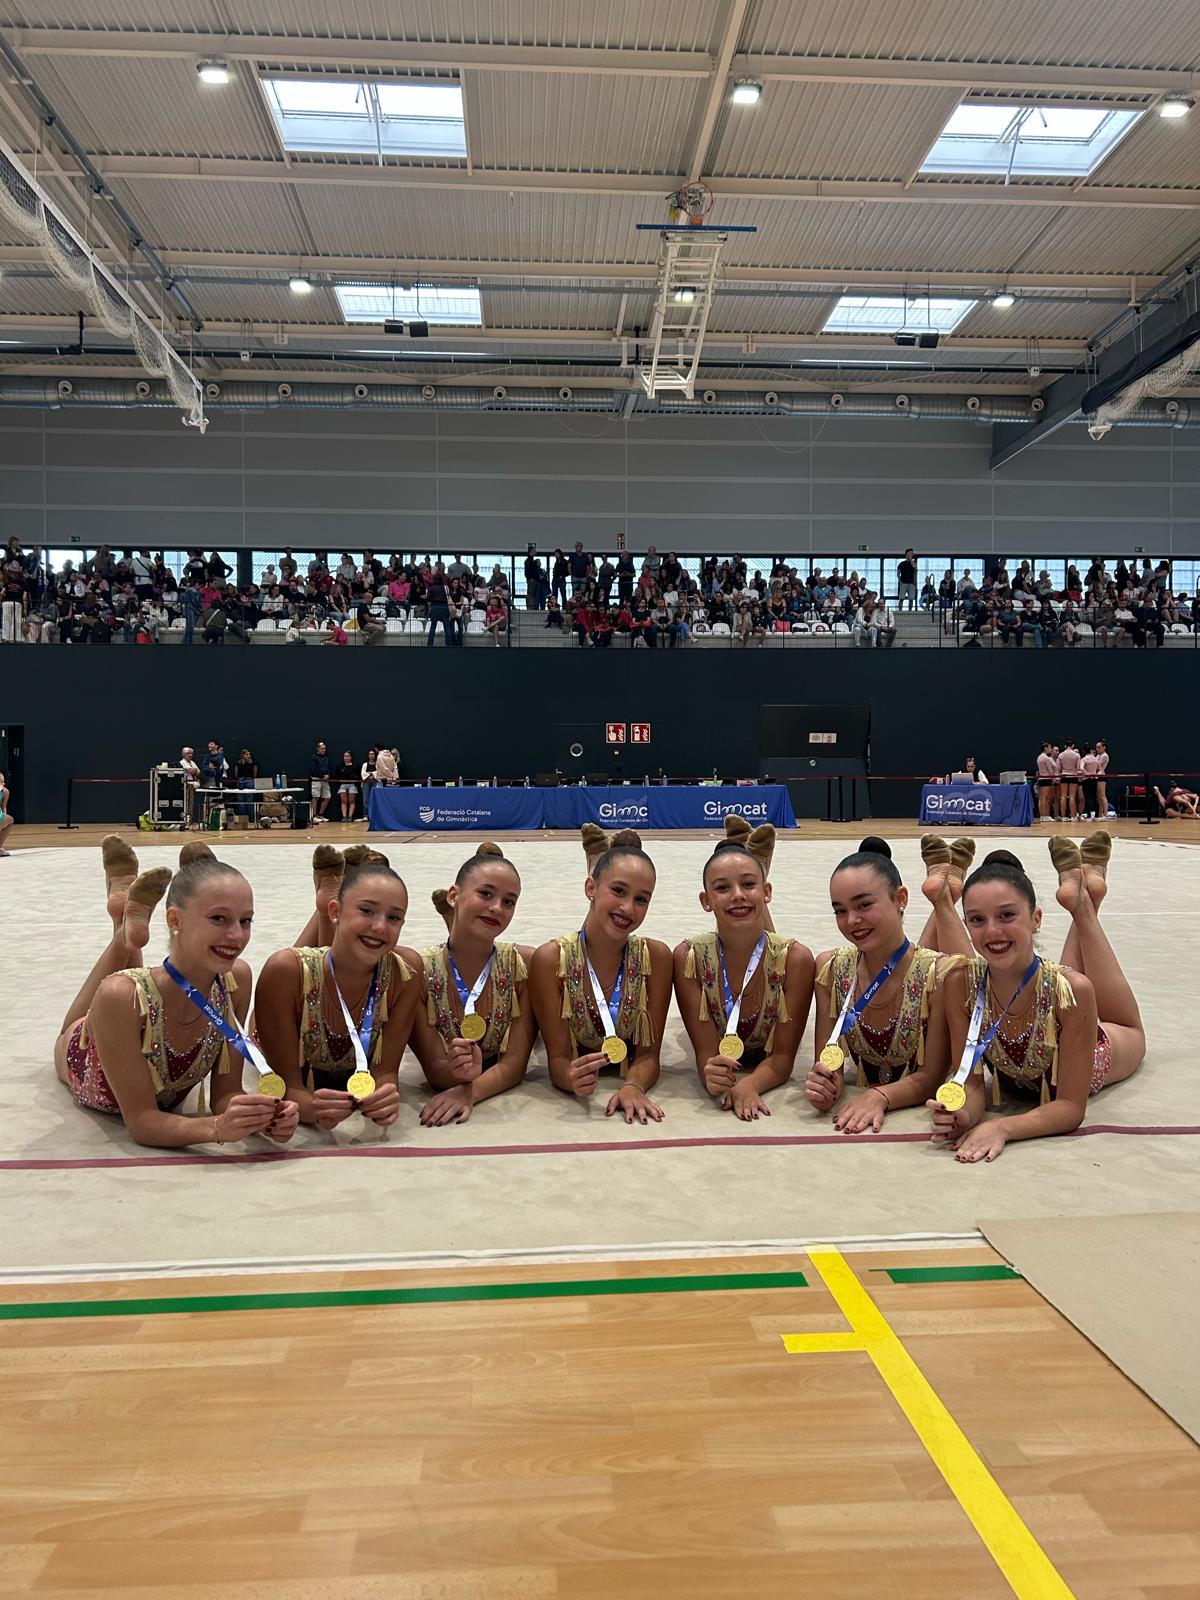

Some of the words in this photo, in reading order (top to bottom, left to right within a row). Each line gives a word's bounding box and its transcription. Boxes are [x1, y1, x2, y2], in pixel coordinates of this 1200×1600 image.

[704, 801, 767, 815] Gimcat
[926, 794, 991, 811] Gimcat
[599, 803, 648, 817] Gimc
